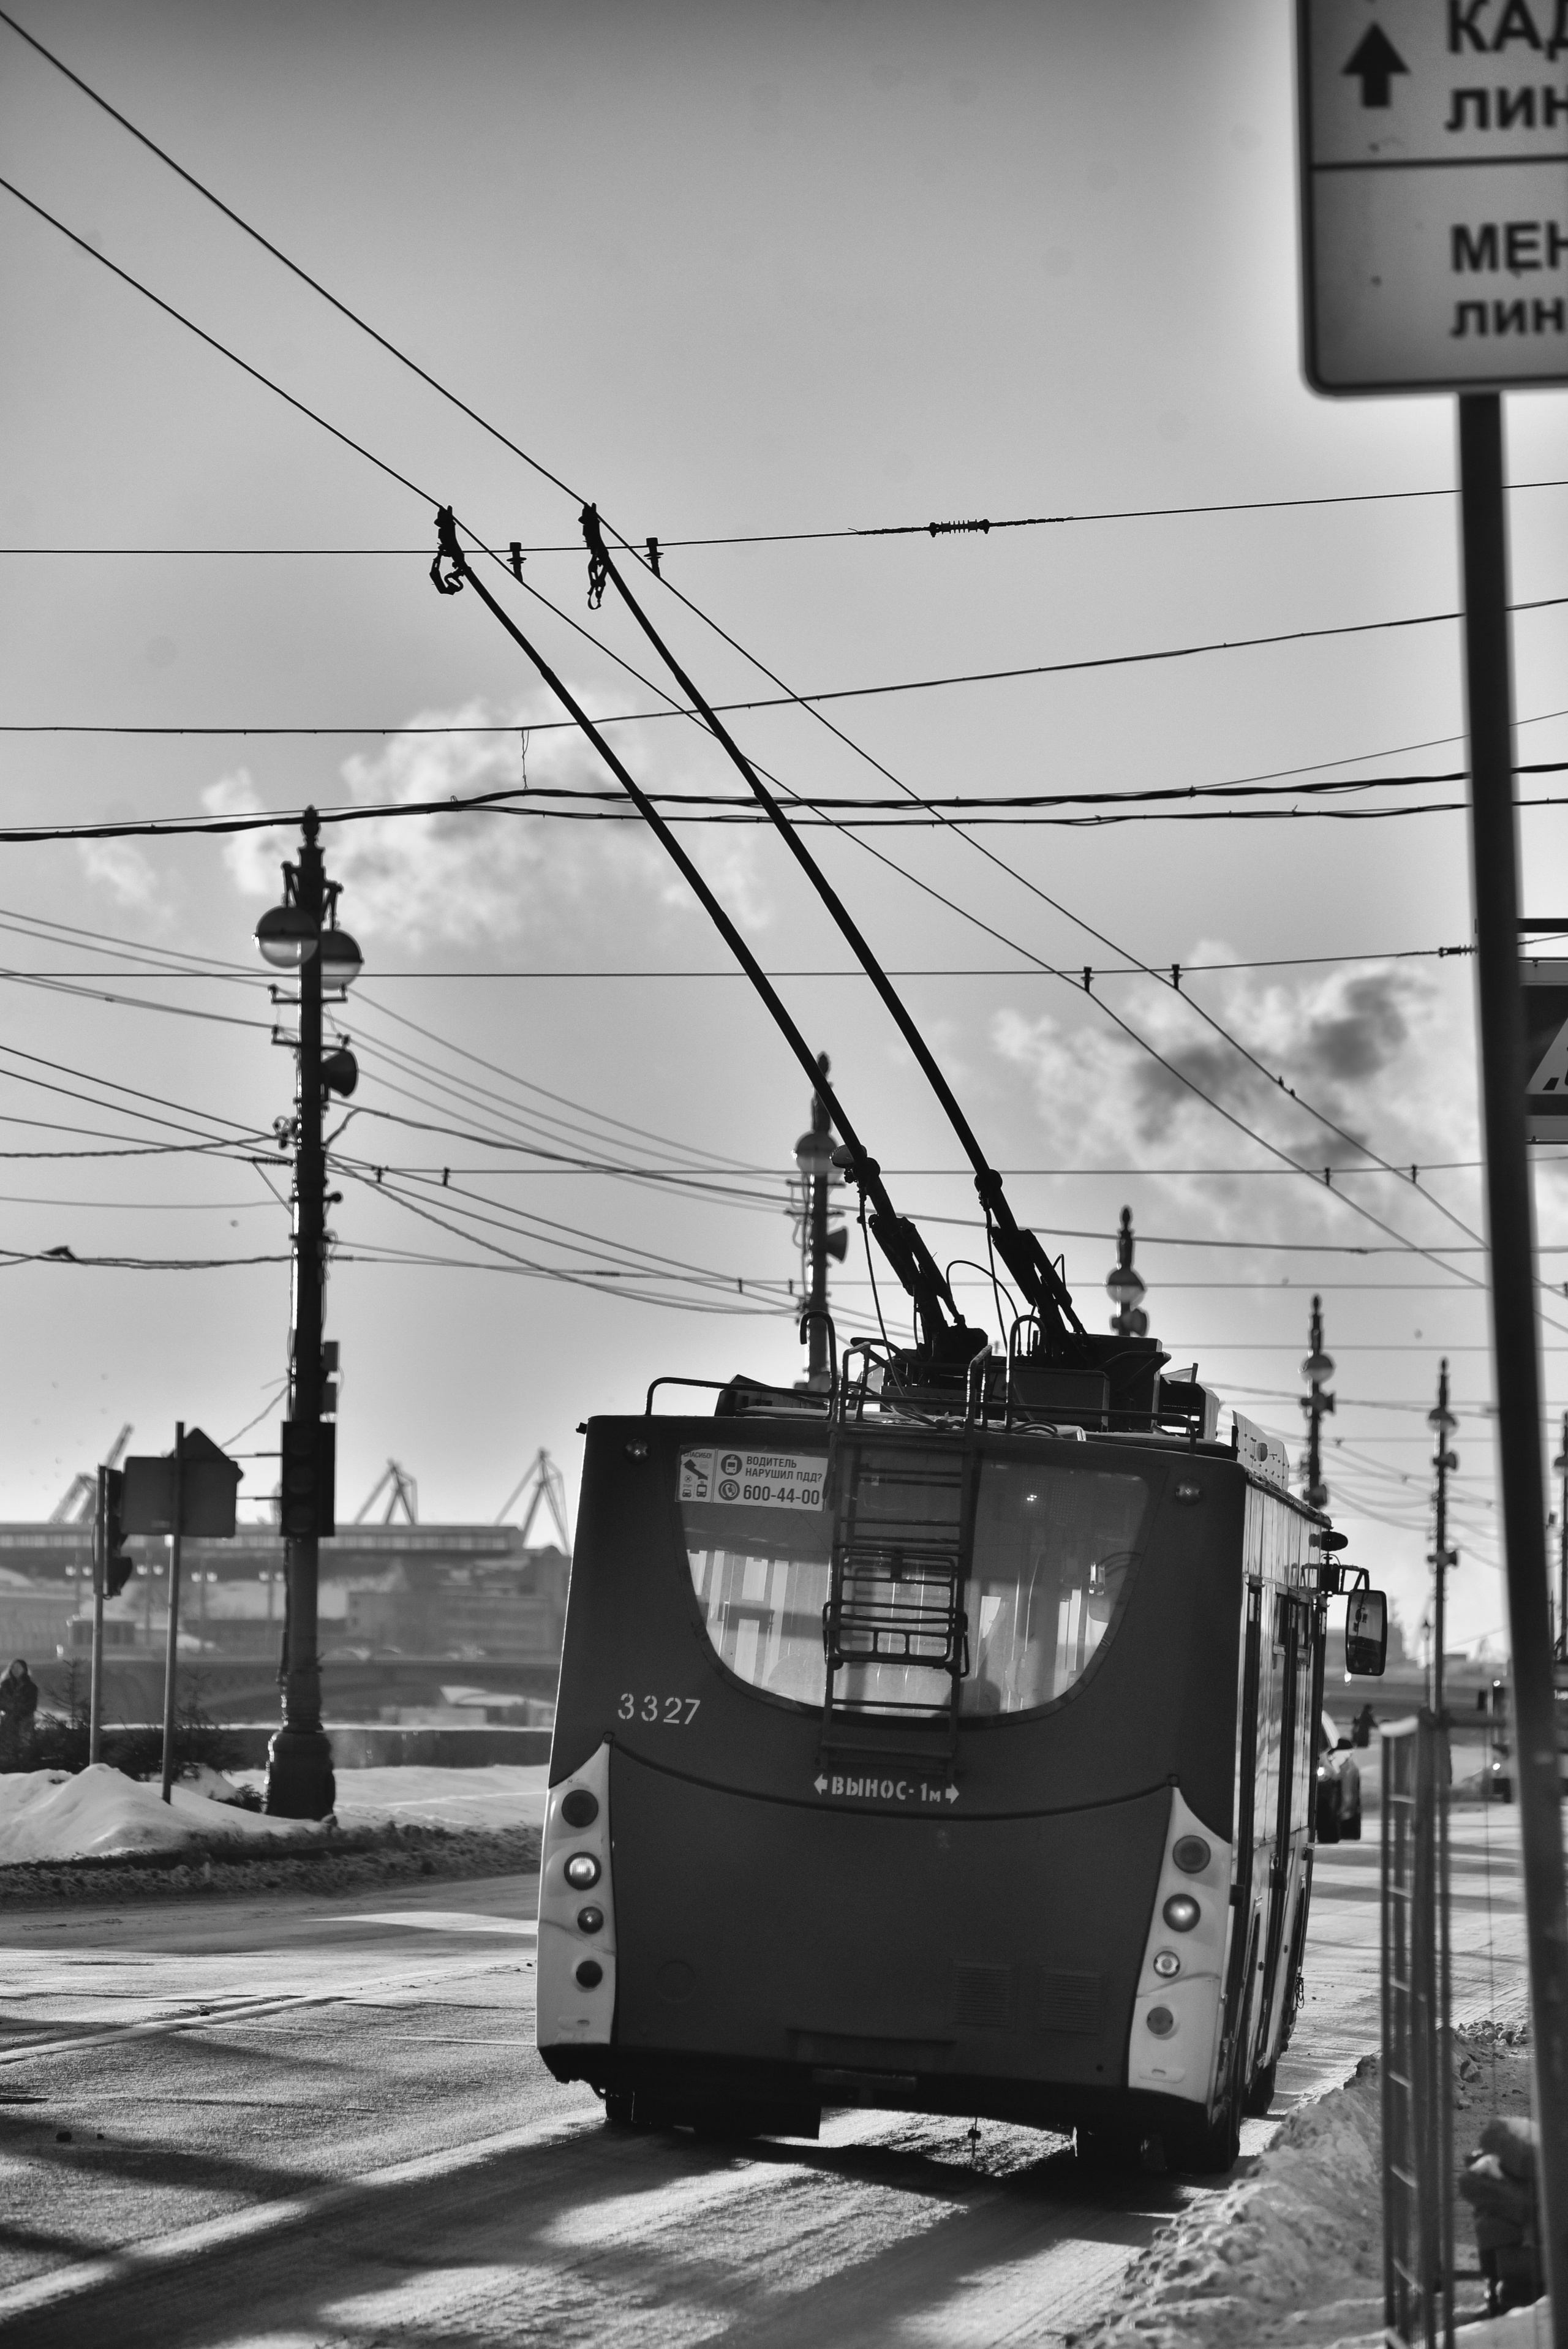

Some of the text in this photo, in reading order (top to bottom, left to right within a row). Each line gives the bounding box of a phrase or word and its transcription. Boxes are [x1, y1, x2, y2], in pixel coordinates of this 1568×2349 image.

[1450, 297, 1566, 337] ЛИН
[746, 1456, 797, 1468] ВОДИТЕЛЬ
[745, 1468, 823, 1483] НАРУШИЛ ПДД?
[743, 1485, 820, 1505] 600-44-00
[618, 1693, 701, 1725] 3327
